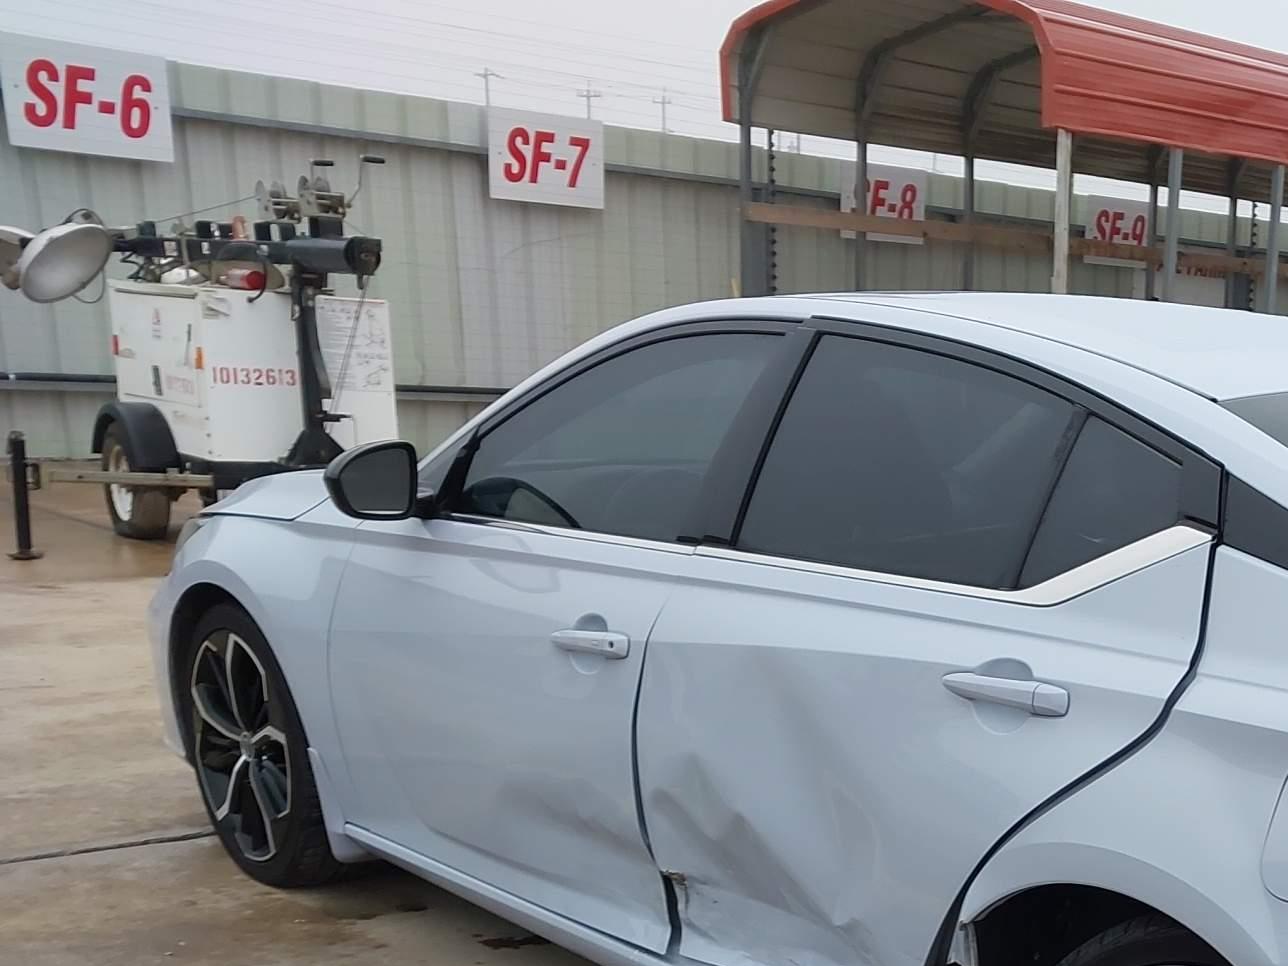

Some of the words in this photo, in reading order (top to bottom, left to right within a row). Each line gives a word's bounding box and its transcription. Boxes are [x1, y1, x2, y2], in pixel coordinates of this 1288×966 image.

[24, 58, 153, 139] SF-6
[503, 126, 591, 188] SF-7
[854, 179, 918, 220] F-8
